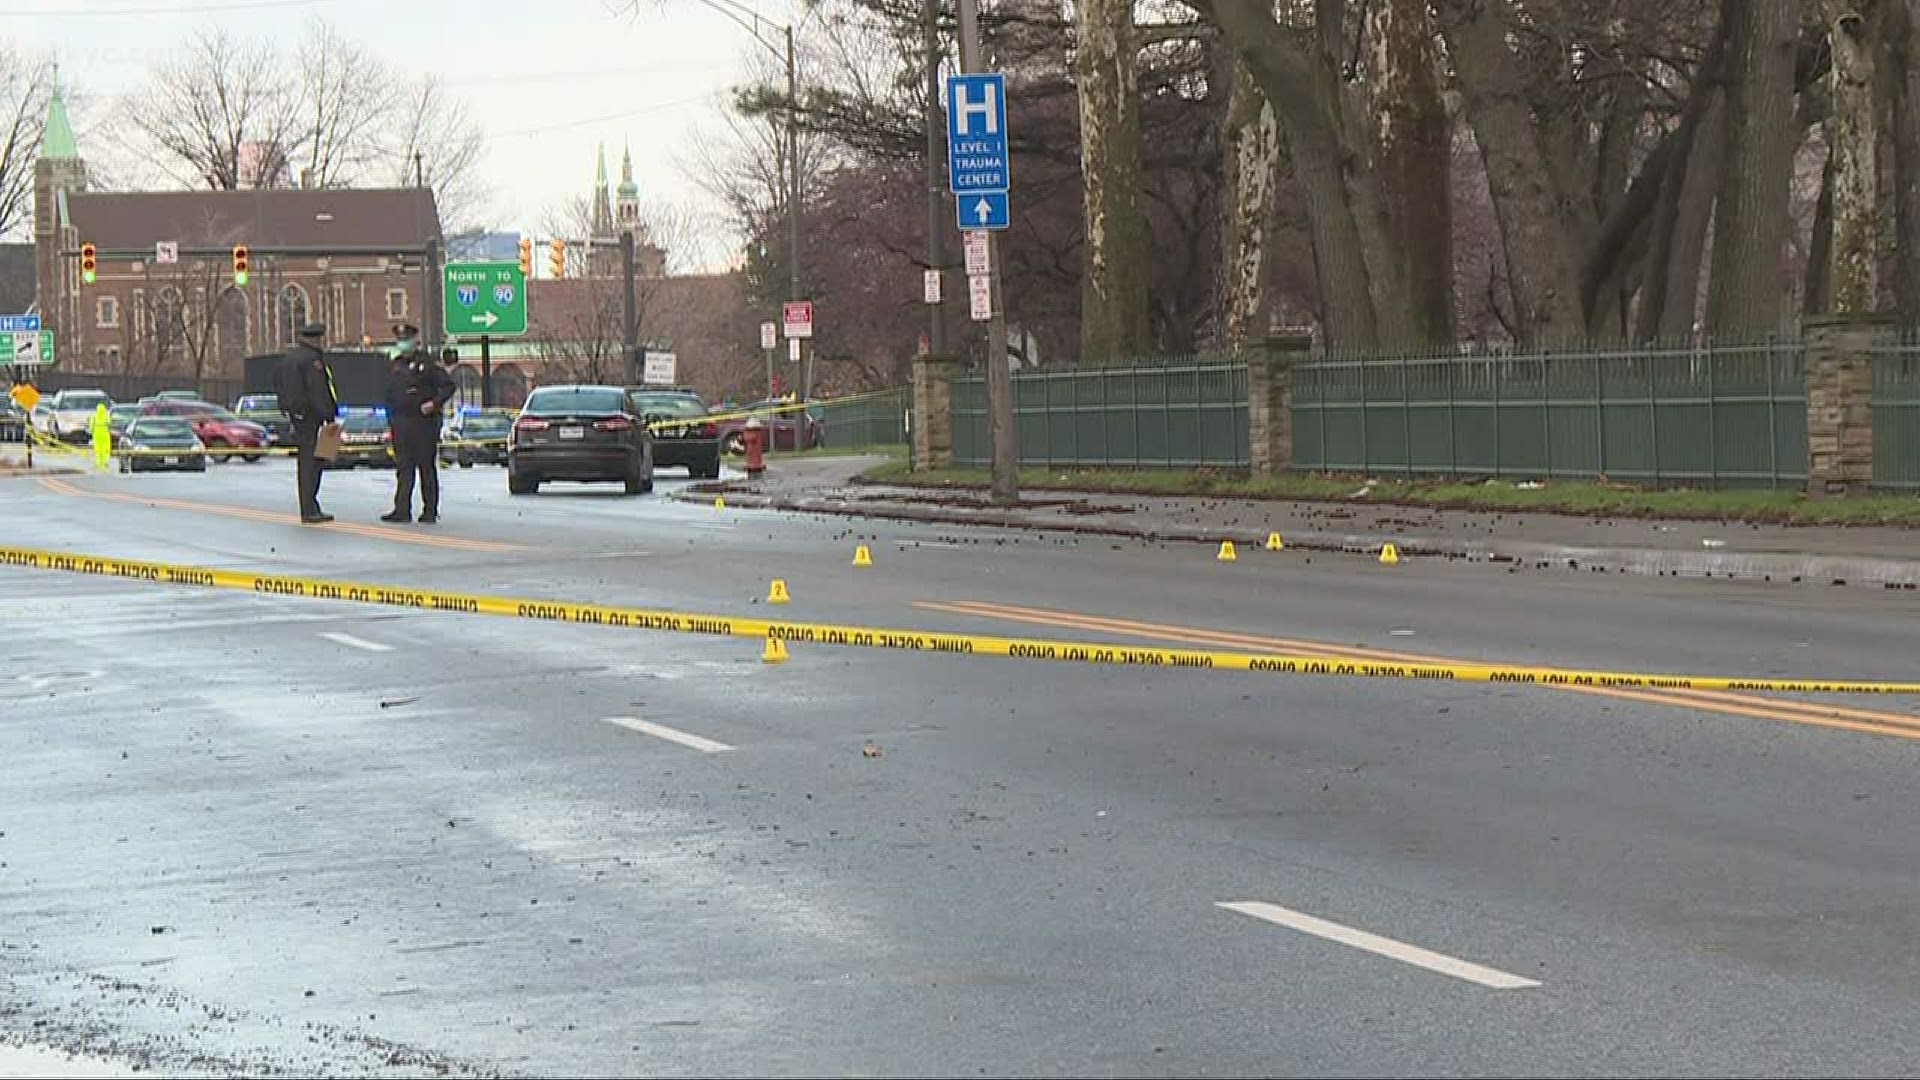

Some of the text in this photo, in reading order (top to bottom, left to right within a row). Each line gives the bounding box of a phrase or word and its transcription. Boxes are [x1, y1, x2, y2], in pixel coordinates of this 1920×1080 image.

[956, 83, 998, 136] H
[954, 142, 990, 154] LEVEL
[955, 158, 1002, 170] TRAUMA
[958, 174, 1001, 186] CENTER
[448, 270, 512, 282] NORTH TO
[460, 288, 512, 302] 71 90
